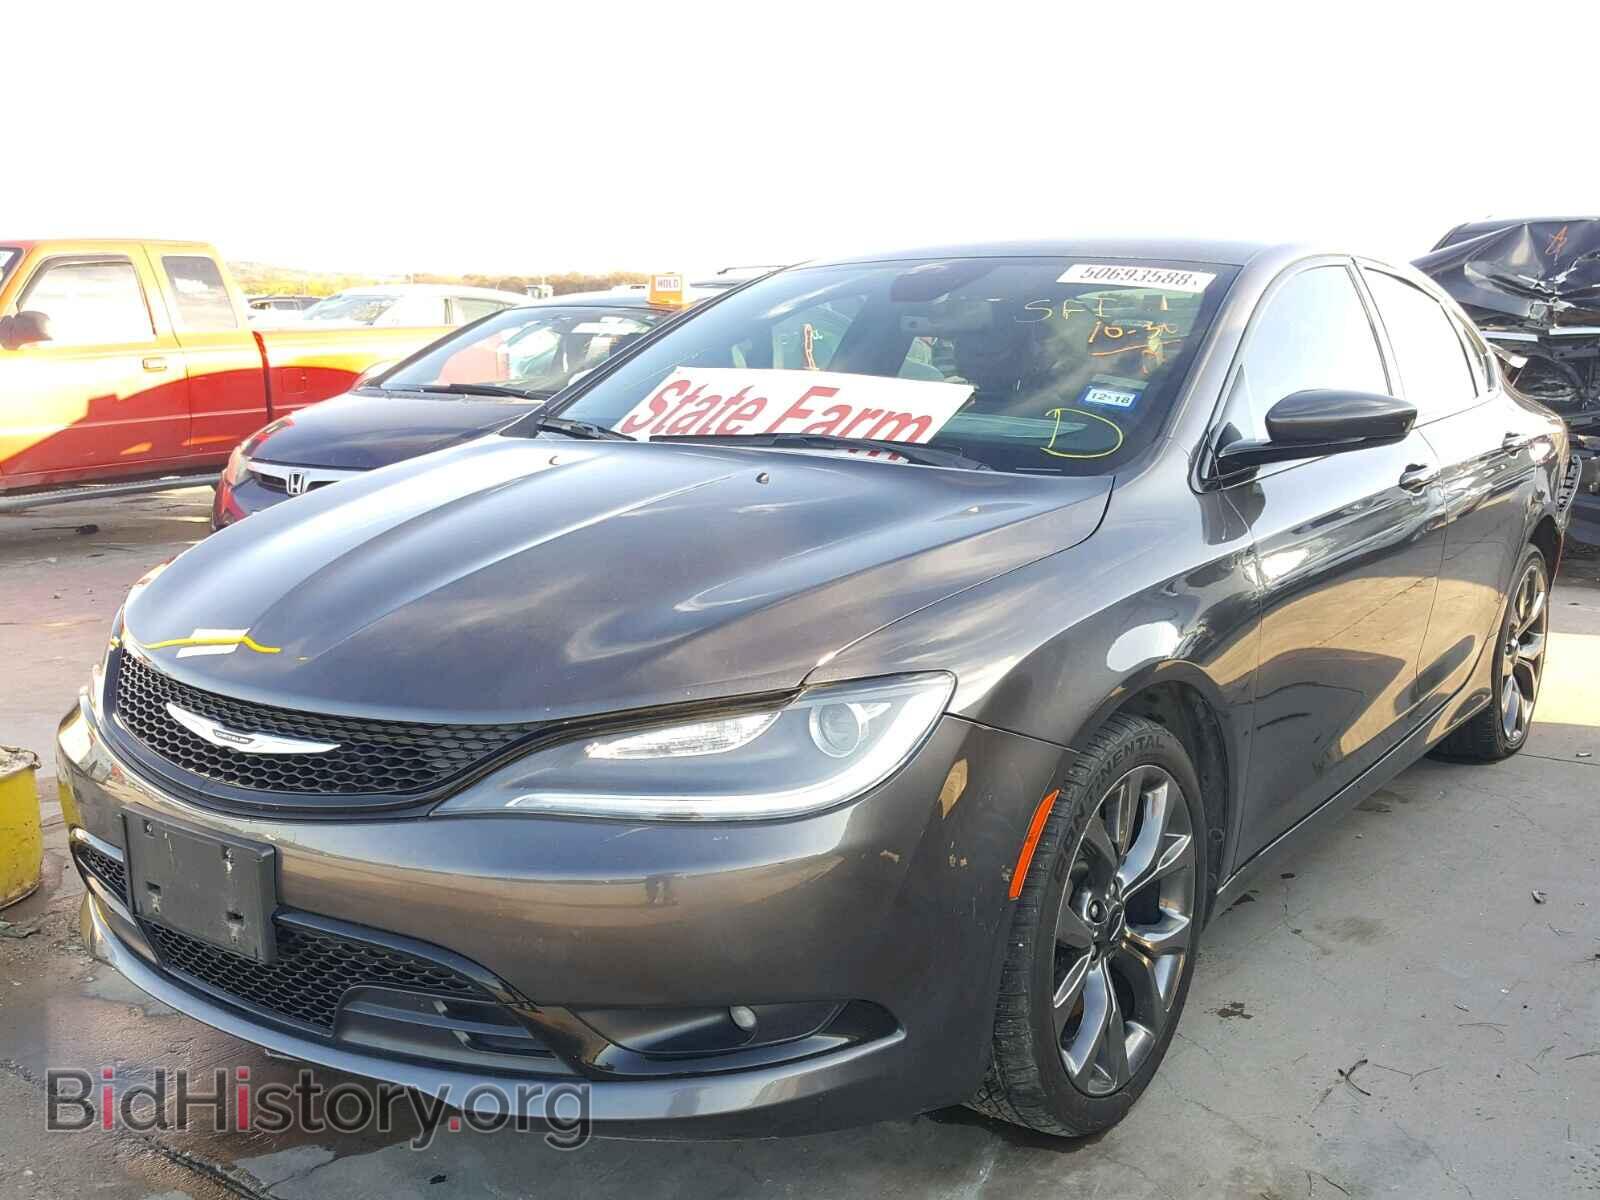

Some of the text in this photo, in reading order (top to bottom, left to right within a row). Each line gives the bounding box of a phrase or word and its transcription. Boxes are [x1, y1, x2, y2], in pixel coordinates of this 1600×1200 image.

[1080, 265, 1193, 286] 50693588
[657, 279, 679, 289] HOLD
[1091, 392, 1130, 404] 12-18
[620, 378, 934, 459] State Farm
